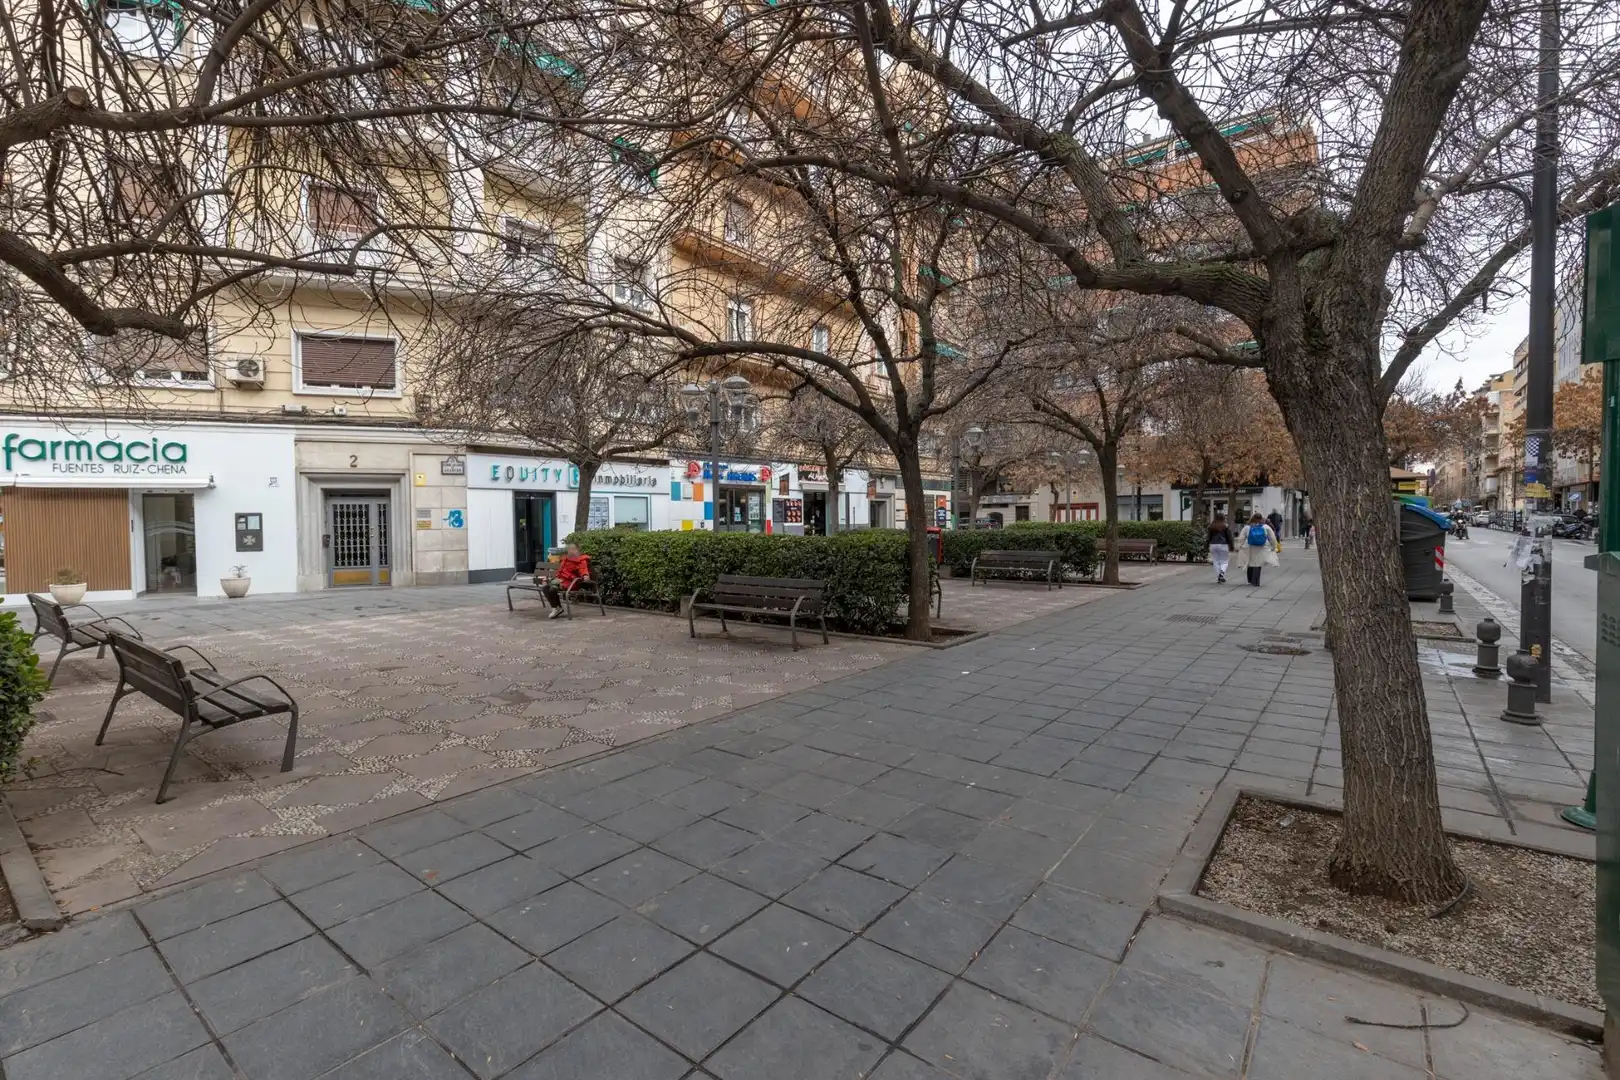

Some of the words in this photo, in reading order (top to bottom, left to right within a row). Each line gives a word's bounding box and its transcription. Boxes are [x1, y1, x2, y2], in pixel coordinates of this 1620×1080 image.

[2, 433, 188, 471] farmacia
[52, 463, 105, 474] FUENTES
[113, 463, 188, 475] RUIZ-CHENA
[349, 454, 358, 468] 2
[490, 464, 564, 483] EQUITY
